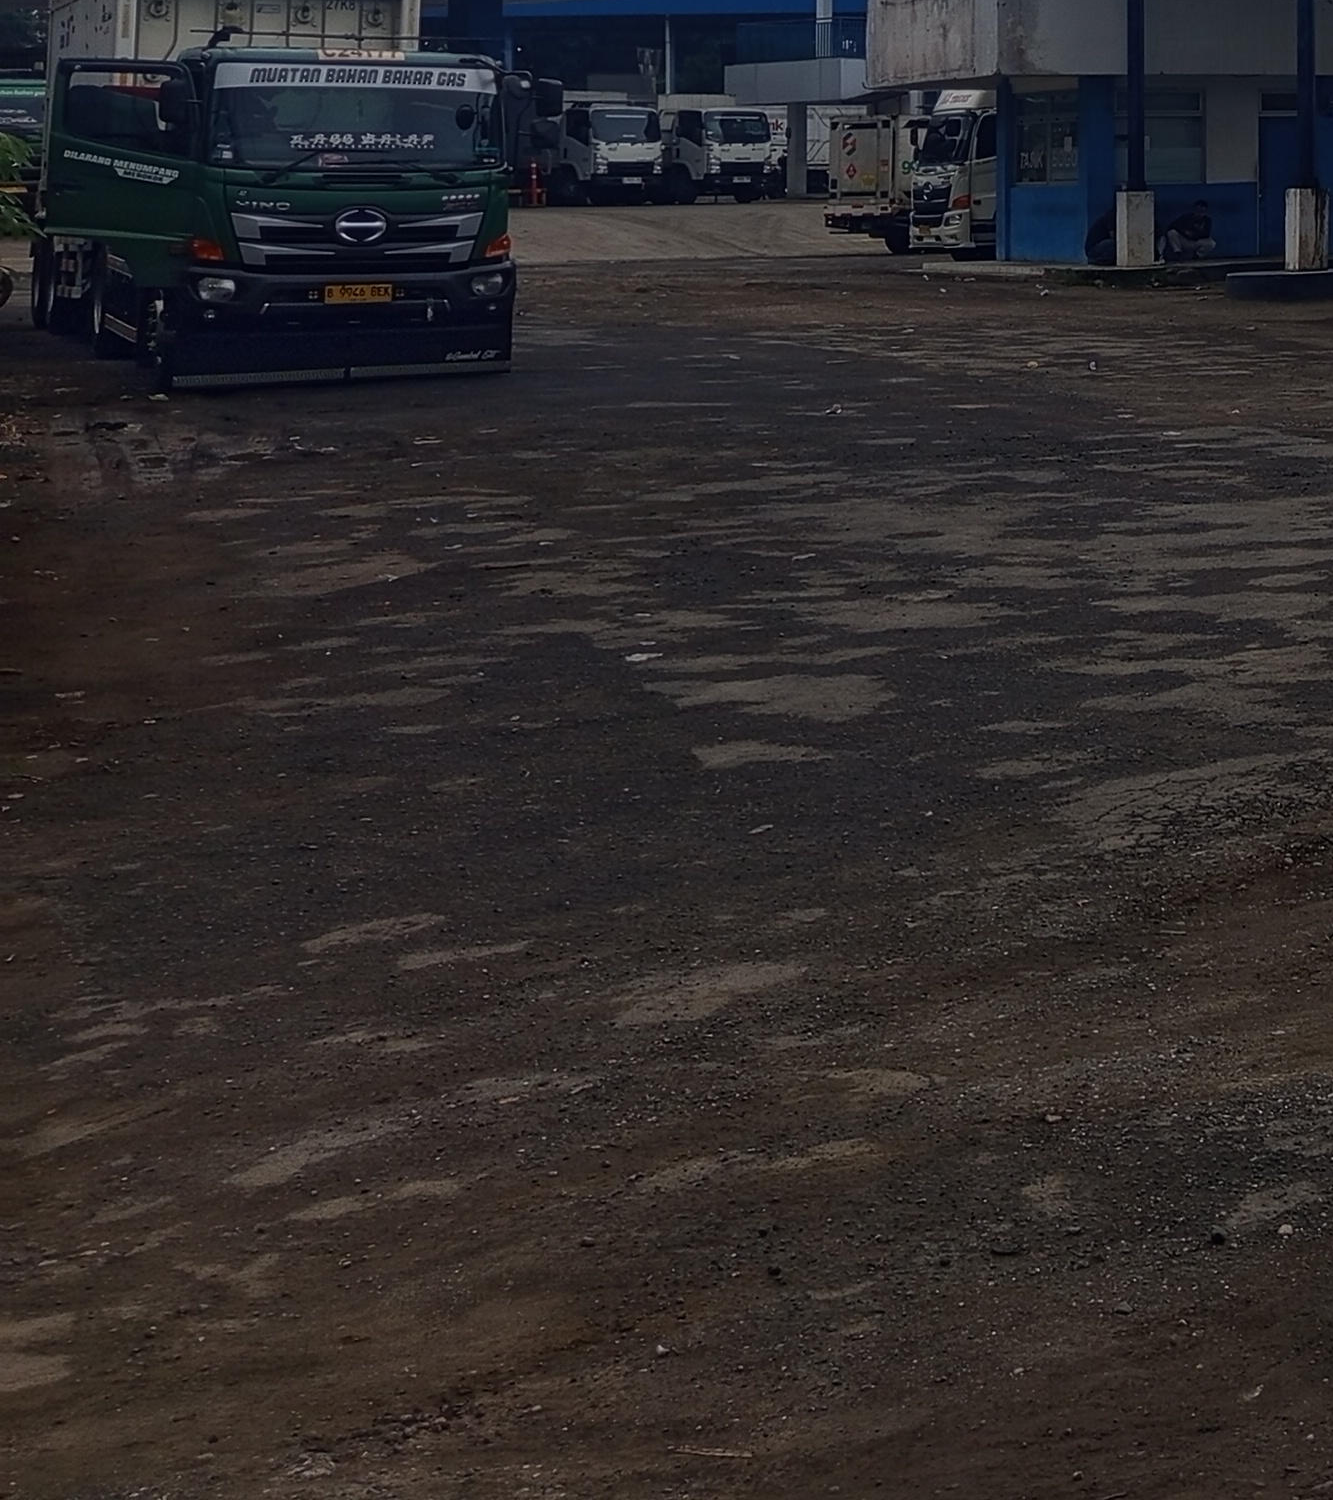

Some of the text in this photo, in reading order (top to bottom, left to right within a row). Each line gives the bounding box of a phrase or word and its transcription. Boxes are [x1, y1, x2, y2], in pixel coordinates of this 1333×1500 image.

[250, 67, 467, 87] MUATAN BAHAN BAKAR GAS
[63, 150, 179, 178] DILARANG MENUMPANG
